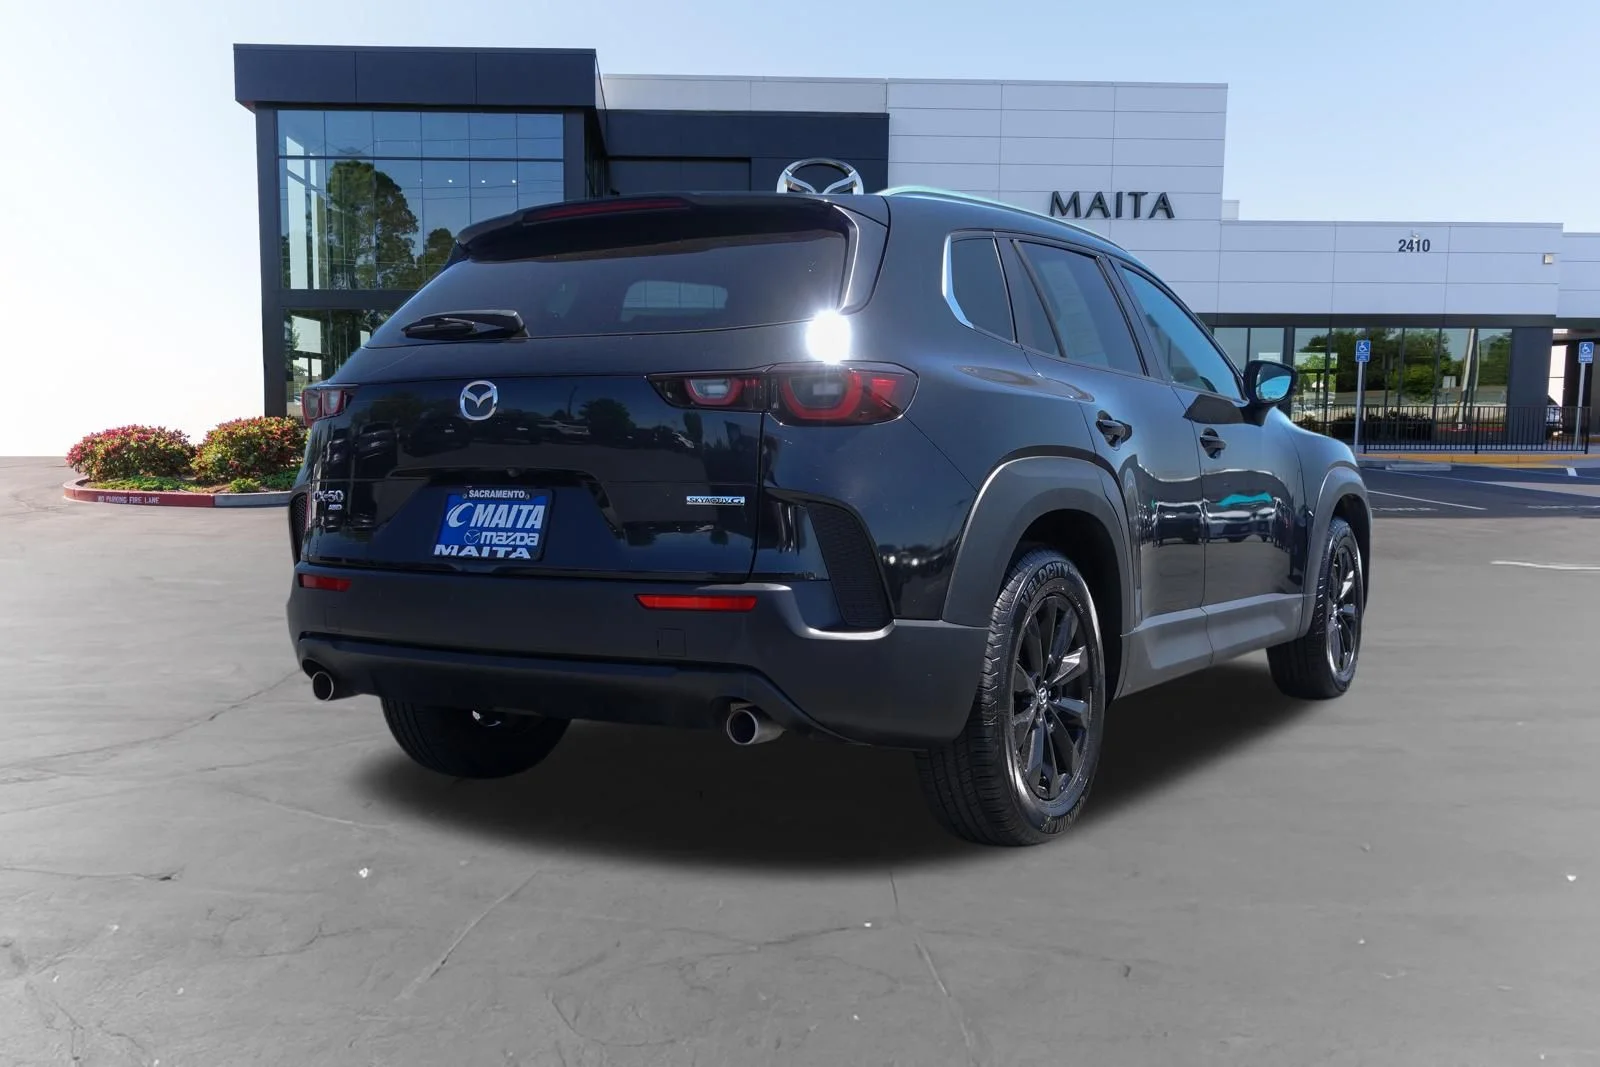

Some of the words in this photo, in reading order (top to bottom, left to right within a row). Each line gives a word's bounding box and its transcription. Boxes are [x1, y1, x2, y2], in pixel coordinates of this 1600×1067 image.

[1049, 190, 1176, 219] MAITA
[1398, 239, 1431, 253] 2410
[106, 496, 128, 504] PARKING
[469, 489, 525, 499] SACRAMENTO
[469, 503, 546, 529] MAITA
[434, 544, 531, 559] MAITA
